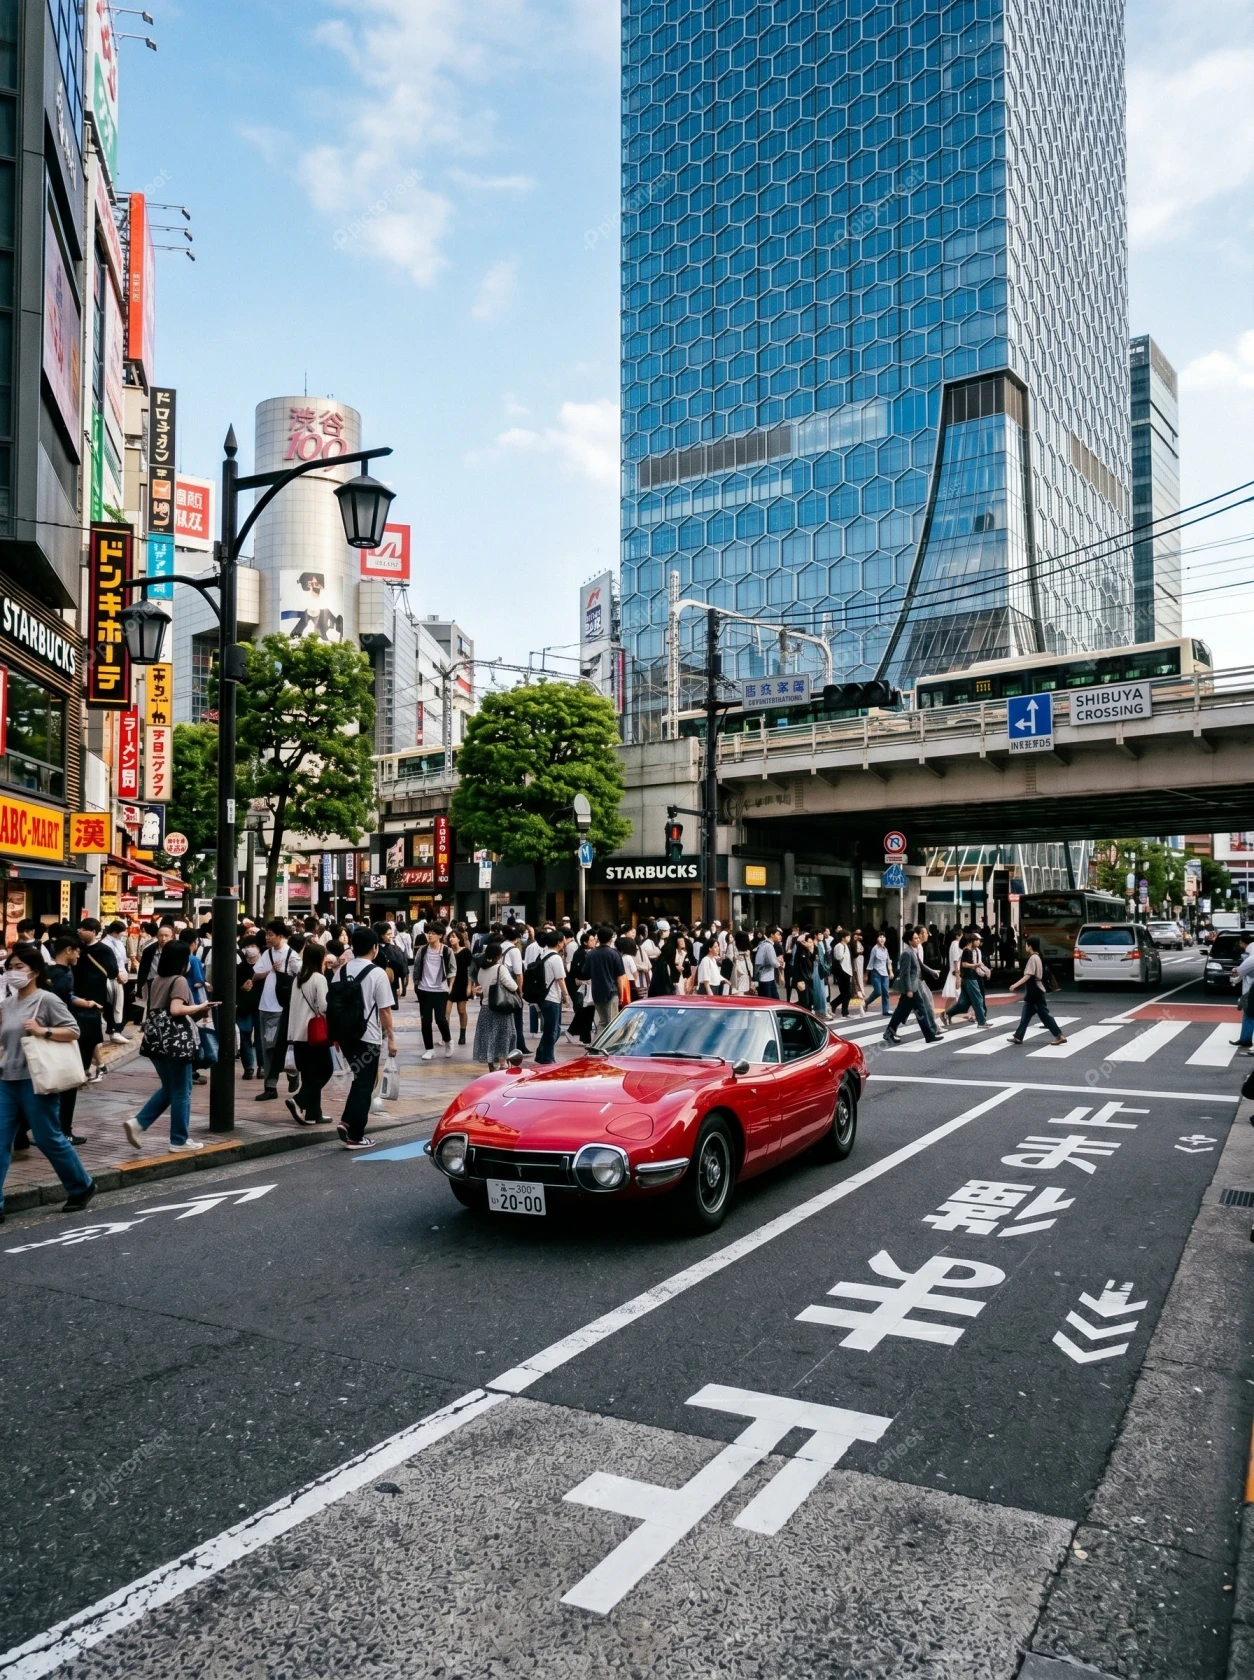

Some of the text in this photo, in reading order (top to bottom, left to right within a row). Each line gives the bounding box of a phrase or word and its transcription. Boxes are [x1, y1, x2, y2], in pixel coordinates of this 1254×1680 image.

[289, 407, 344, 437] 渋谷
[98, 539, 122, 690] ドンキホーテ
[3, 597, 76, 676] STARBUCKS
[1076, 688, 1143, 708] SHIBUYA
[1077, 703, 1144, 721] CROSSING
[0, 805, 59, 850] ABC-MART
[606, 864, 698, 880] STARBUCKS
[501, 1194, 542, 1213] 20-00
